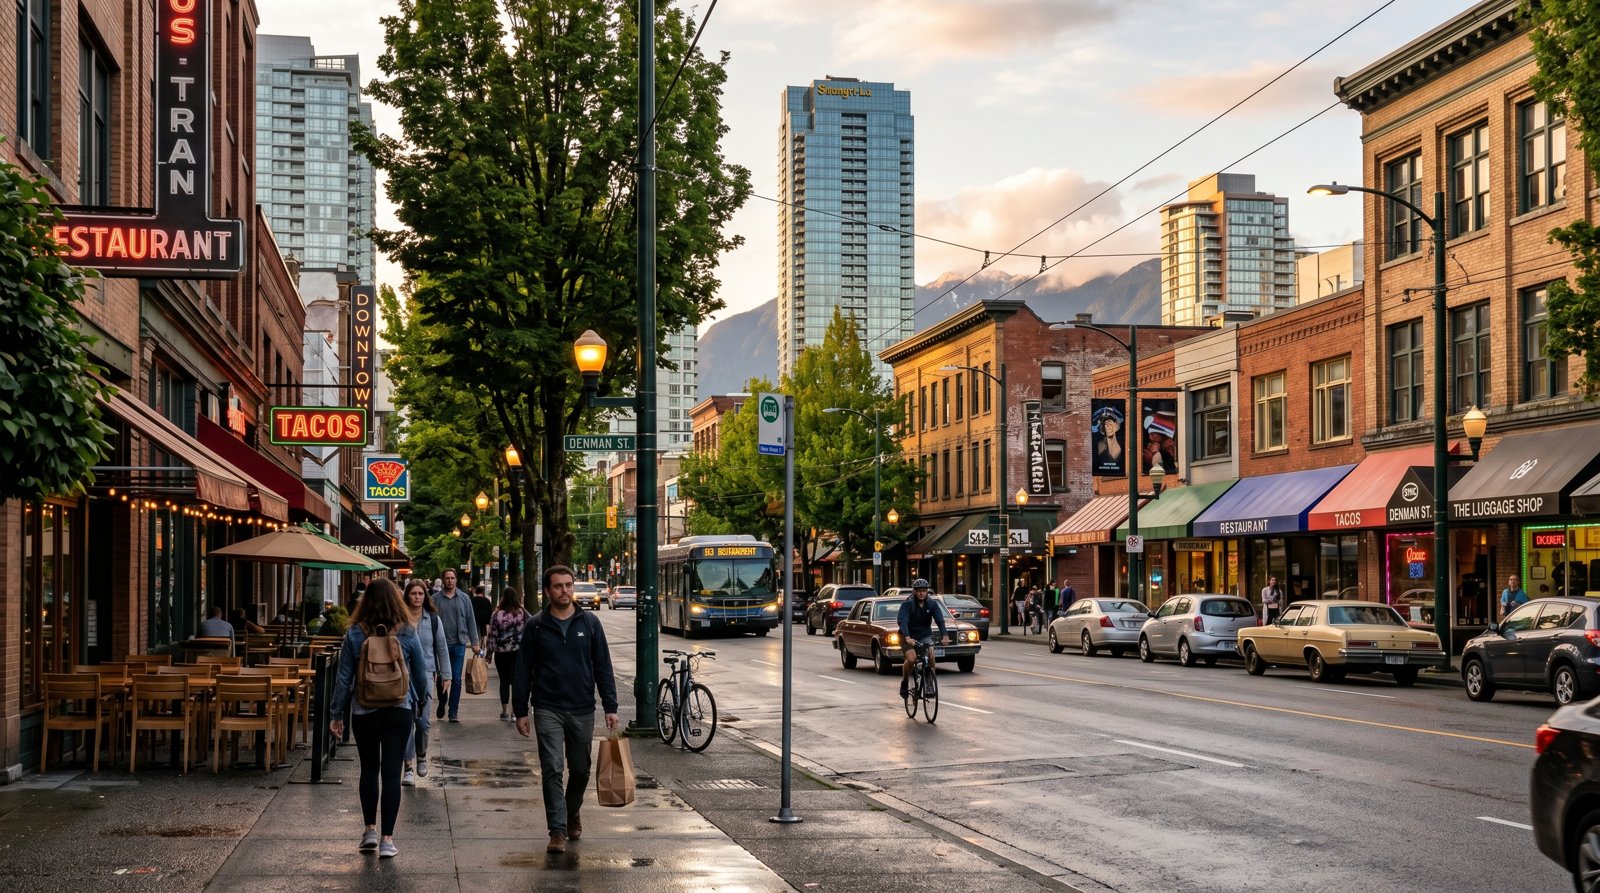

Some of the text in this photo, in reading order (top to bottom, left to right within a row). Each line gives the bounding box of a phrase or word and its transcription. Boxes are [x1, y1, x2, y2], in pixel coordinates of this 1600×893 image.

[33, 225, 232, 261] ESTAURANT
[277, 414, 360, 438] TACOS
[569, 437, 630, 449] DENMAN ST.
[368, 486, 406, 497] TACOS
[1389, 504, 1433, 521] DENMAN ST.
[1453, 497, 1543, 517] THE LUGGAGE SHOP
[1220, 519, 1269, 534] RESTAURANT
[1334, 511, 1361, 527] TACOS
